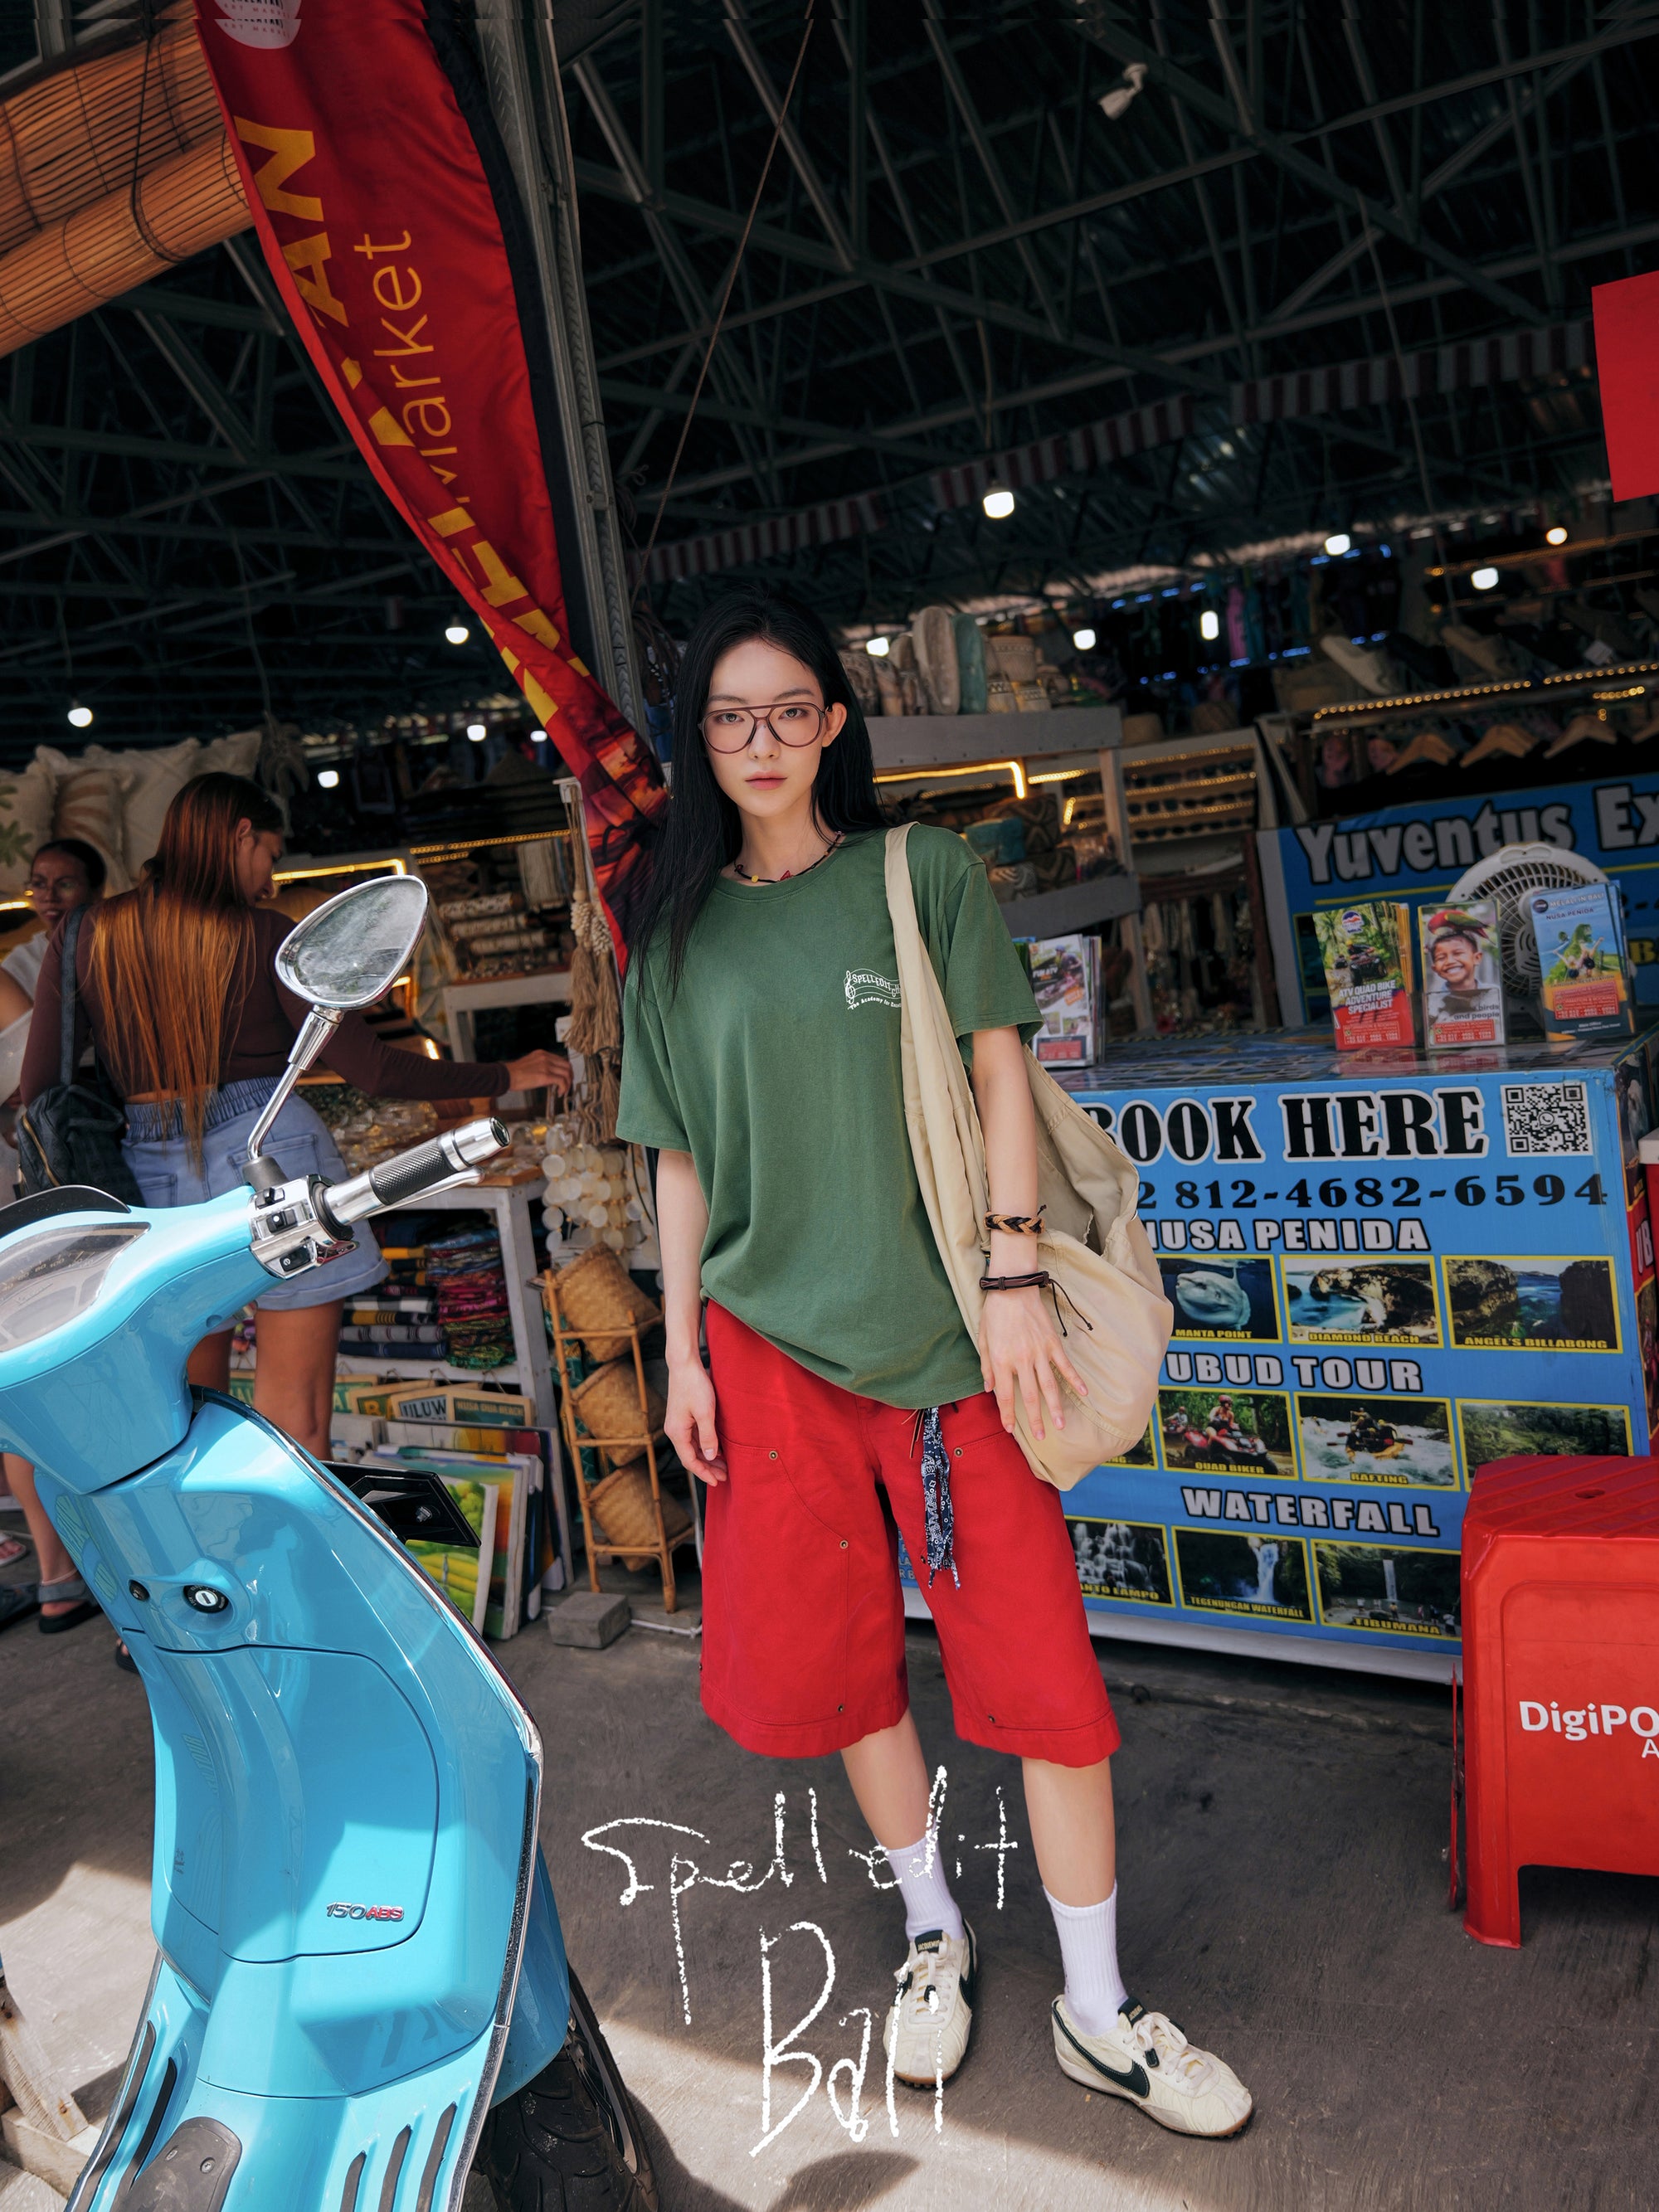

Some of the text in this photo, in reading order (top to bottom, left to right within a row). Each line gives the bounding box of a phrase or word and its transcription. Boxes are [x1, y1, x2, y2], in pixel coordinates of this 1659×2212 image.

[1295, 800, 1576, 884] Yuventus
[852, 974, 891, 991] SPELLEDIT
[1339, 980, 1396, 998] ATV QUAD BIKE
[1345, 990, 1393, 1006] ADVENTURE
[1348, 999, 1394, 1014] SPECIALIST
[1472, 1011, 1500, 1020] people
[1280, 1089, 1488, 1161] HERE
[1253, 1218, 1432, 1252] PENIDA
[1175, 1329, 1253, 1339] MANTA POINT
[1308, 1332, 1420, 1344] DIAMOND BEACH
[1464, 1335, 1608, 1349] ANGEL'S BILLABONG
[1165, 1352, 1424, 1393] UBUD TOUR
[1194, 1461, 1265, 1475] QUAD BIKER
[1350, 1471, 1409, 1485] RAFTING
[1181, 1485, 1440, 1538] WATERFALL
[1112, 1587, 1160, 1601] LAMPO
[1190, 1596, 1305, 1618] TEGENUNGAN WATERFALL
[1353, 1617, 1442, 1636] TIBUMANA
